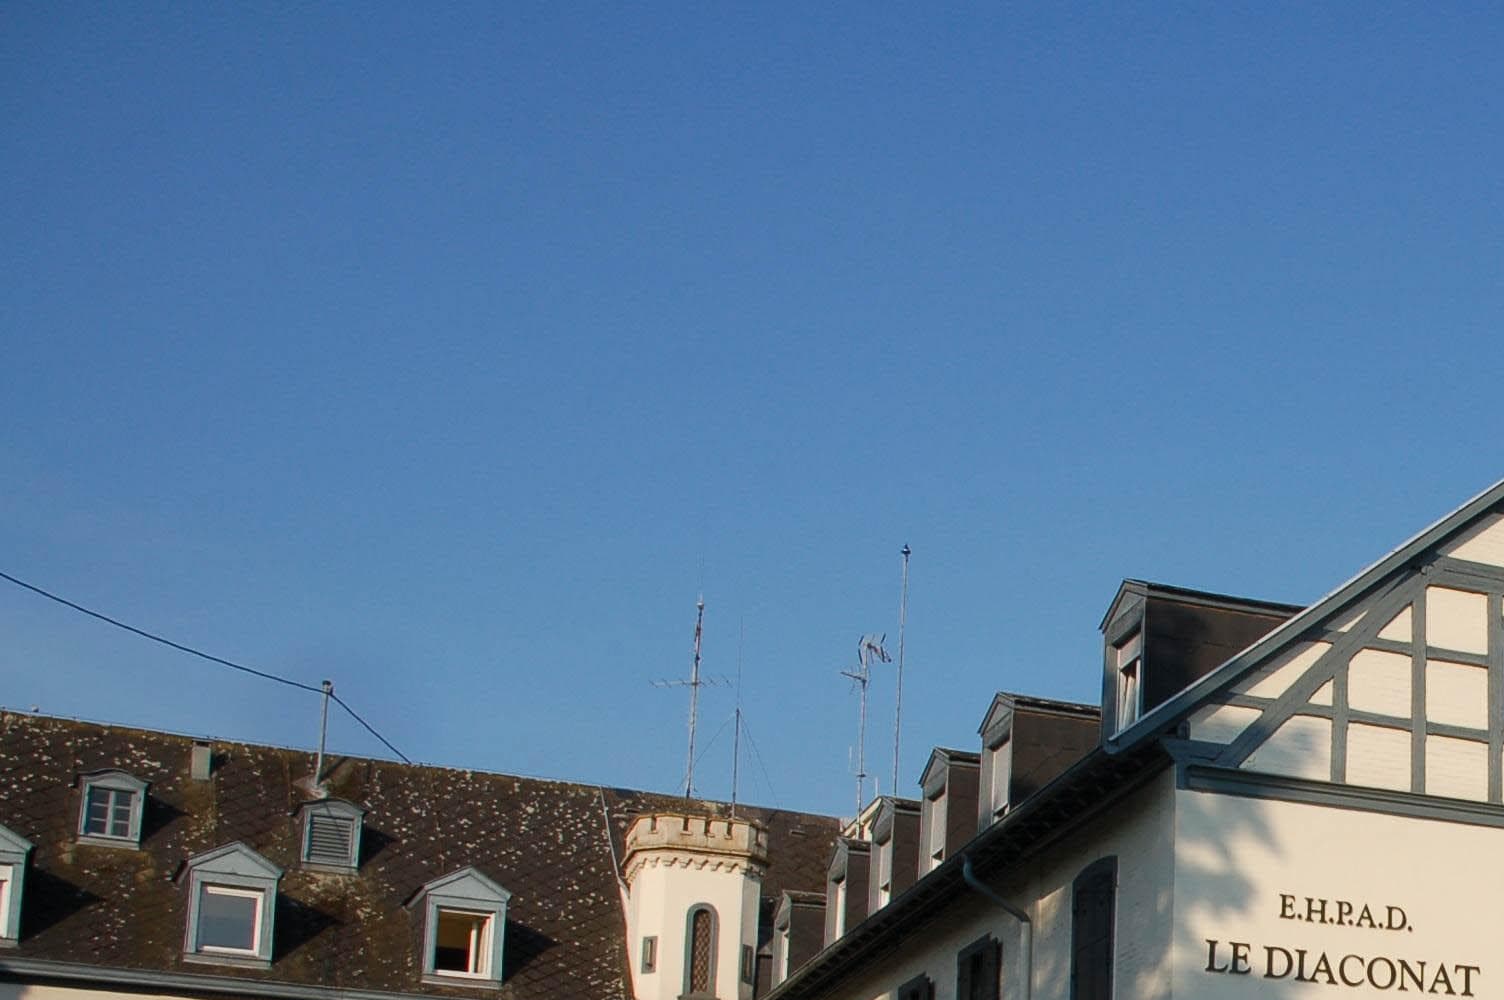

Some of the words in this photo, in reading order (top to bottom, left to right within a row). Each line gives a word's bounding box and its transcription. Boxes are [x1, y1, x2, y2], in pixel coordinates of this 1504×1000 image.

[1279, 893, 1414, 933] E.H.P.A.D.
[1205, 939, 1251, 975] LE
[1263, 946, 1481, 997] DIACONAT
